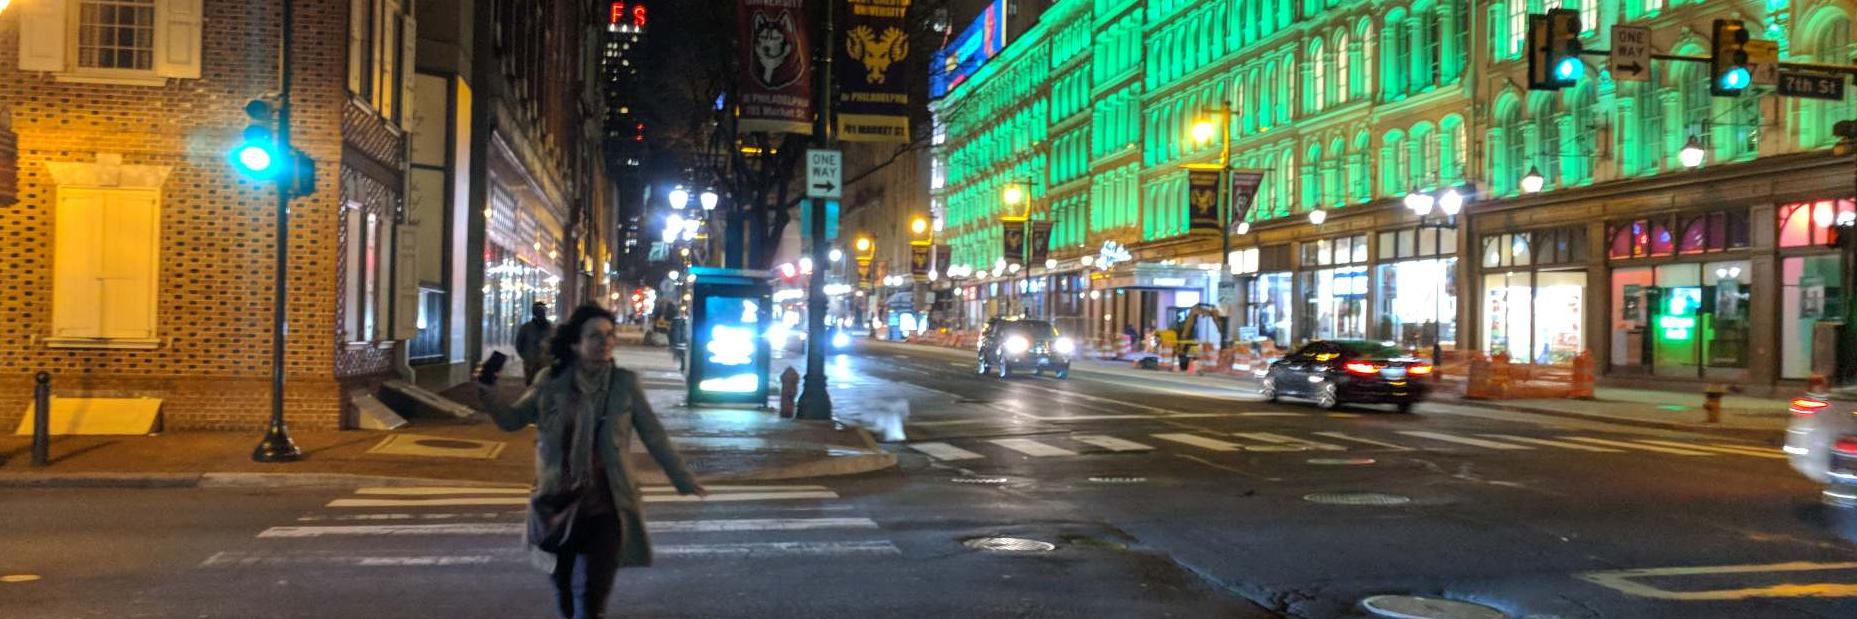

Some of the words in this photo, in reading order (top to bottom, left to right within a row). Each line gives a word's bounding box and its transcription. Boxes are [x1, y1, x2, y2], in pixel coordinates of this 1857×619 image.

[1618, 30, 1645, 44] ONE
[1618, 44, 1645, 57] WAY
[1787, 78, 1812, 89] 7th
[1818, 80, 1836, 93] St
[812, 153, 836, 166] ONE
[812, 166, 839, 177] WAY
